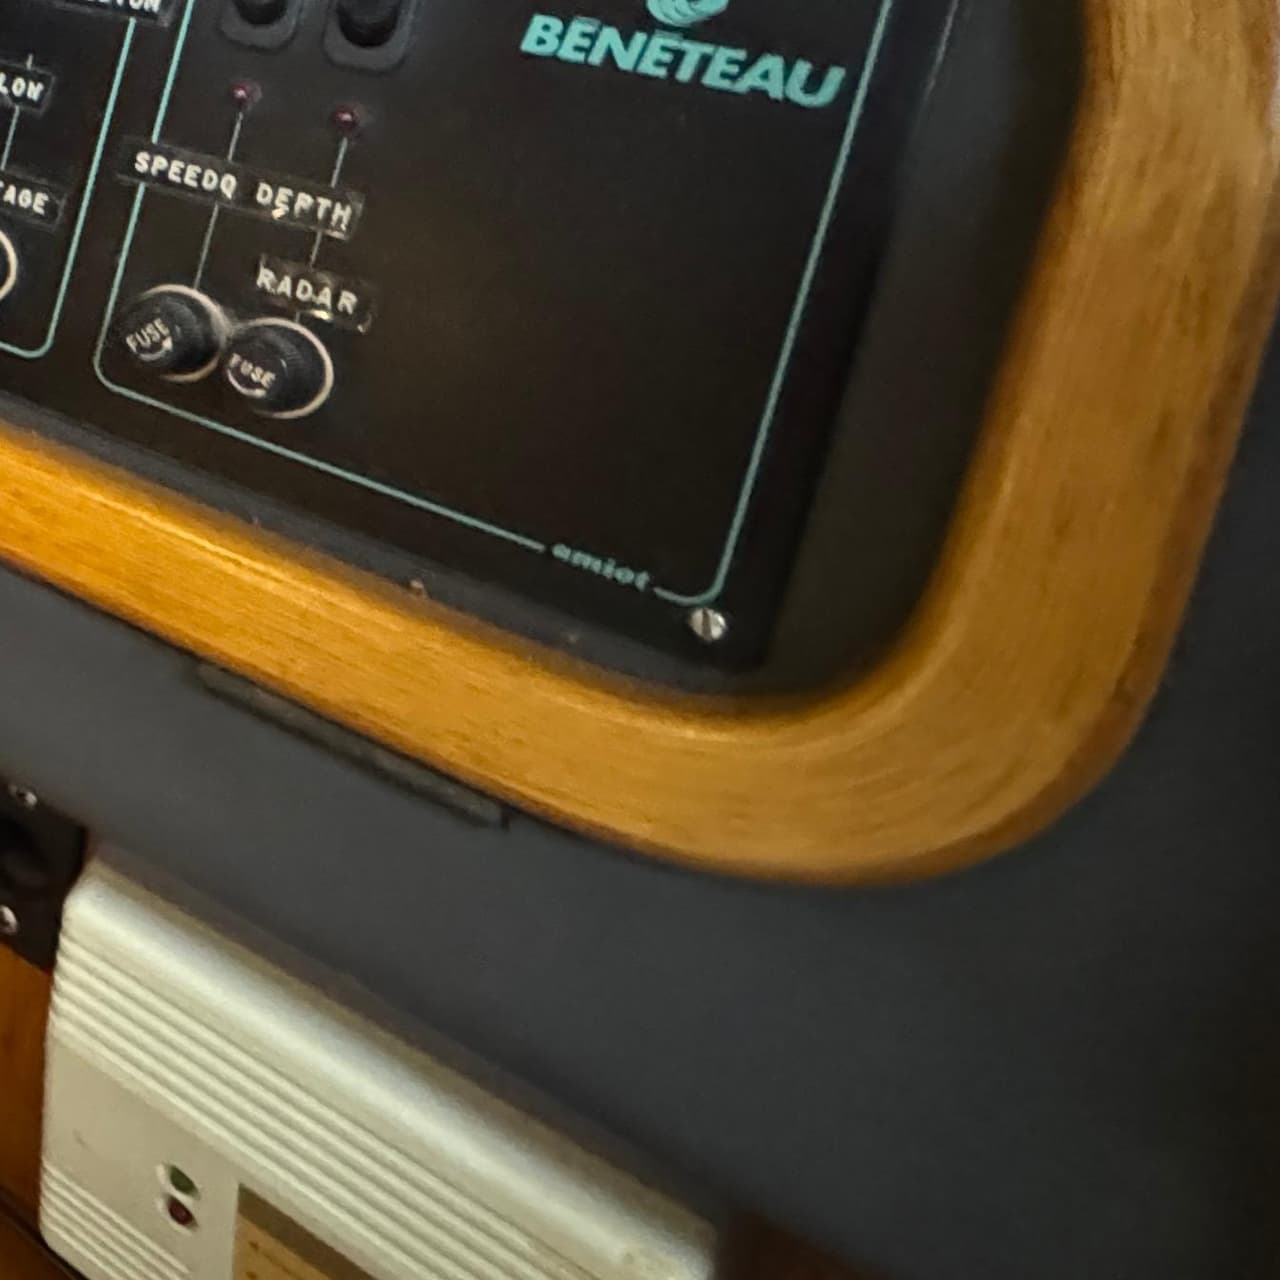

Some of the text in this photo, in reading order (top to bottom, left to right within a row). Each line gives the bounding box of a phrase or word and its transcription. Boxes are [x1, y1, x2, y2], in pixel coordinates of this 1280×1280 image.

[519, 13, 847, 109] BENETEAU
[255, 181, 353, 232] DEPTH
[256, 263, 360, 316] RADAR
[126, 317, 171, 354] FUSE
[227, 352, 277, 390] FUSE
